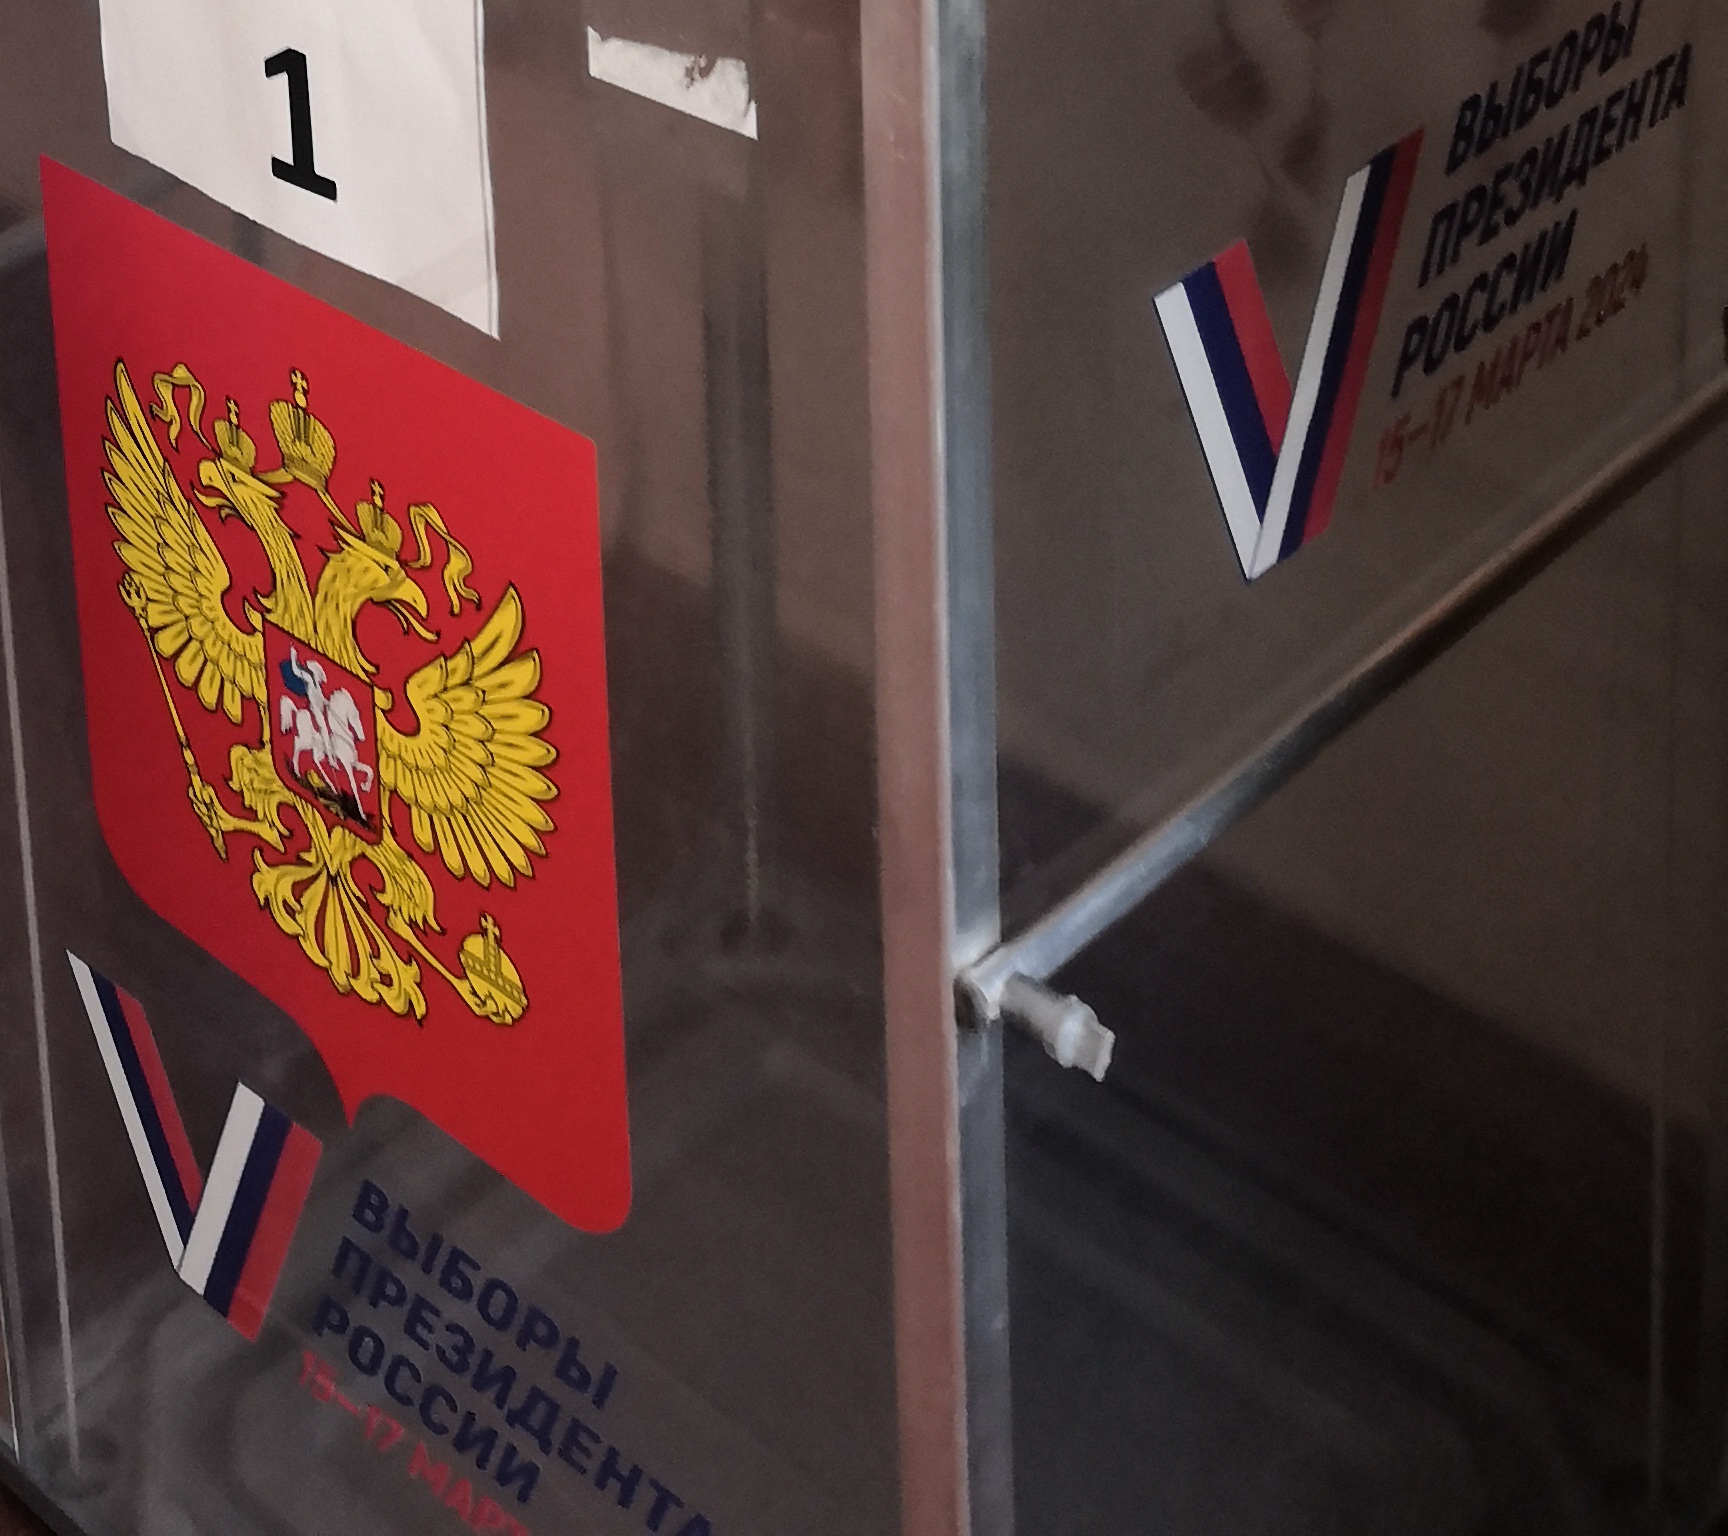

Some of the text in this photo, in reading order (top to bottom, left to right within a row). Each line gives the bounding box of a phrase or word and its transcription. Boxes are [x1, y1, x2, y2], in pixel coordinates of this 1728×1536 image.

[264, 46, 338, 202] 1
[1418, 41, 1692, 289] ПРЕЗИДЕНТА
[1390, 208, 1578, 399] РОССИИ
[310, 1292, 542, 1504] РОССИИ
[351, 1178, 619, 1411] ВЫБОРЫ
